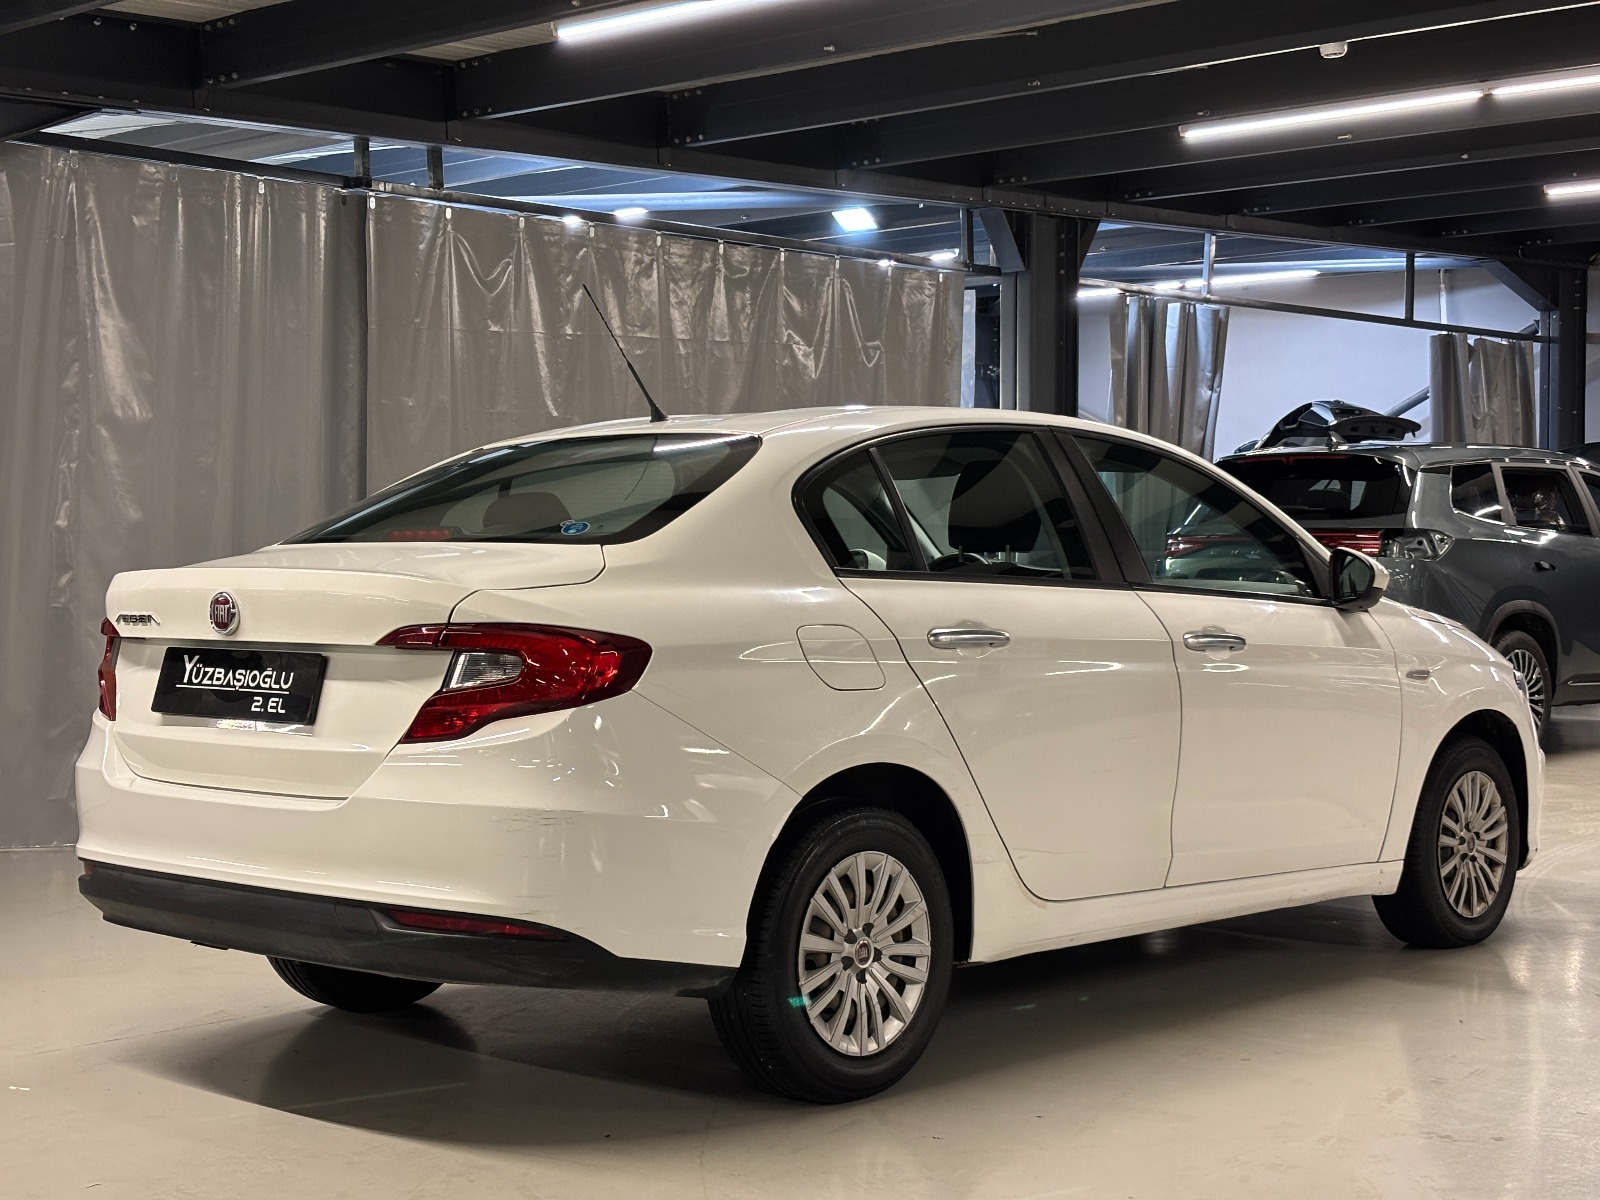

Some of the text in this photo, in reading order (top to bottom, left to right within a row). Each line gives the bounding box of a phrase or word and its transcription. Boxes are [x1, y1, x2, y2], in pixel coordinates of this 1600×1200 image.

[213, 604, 231, 623] FIAT
[183, 654, 294, 690] YÜZBAŞIOĞLU
[251, 697, 286, 714] 2. EL
